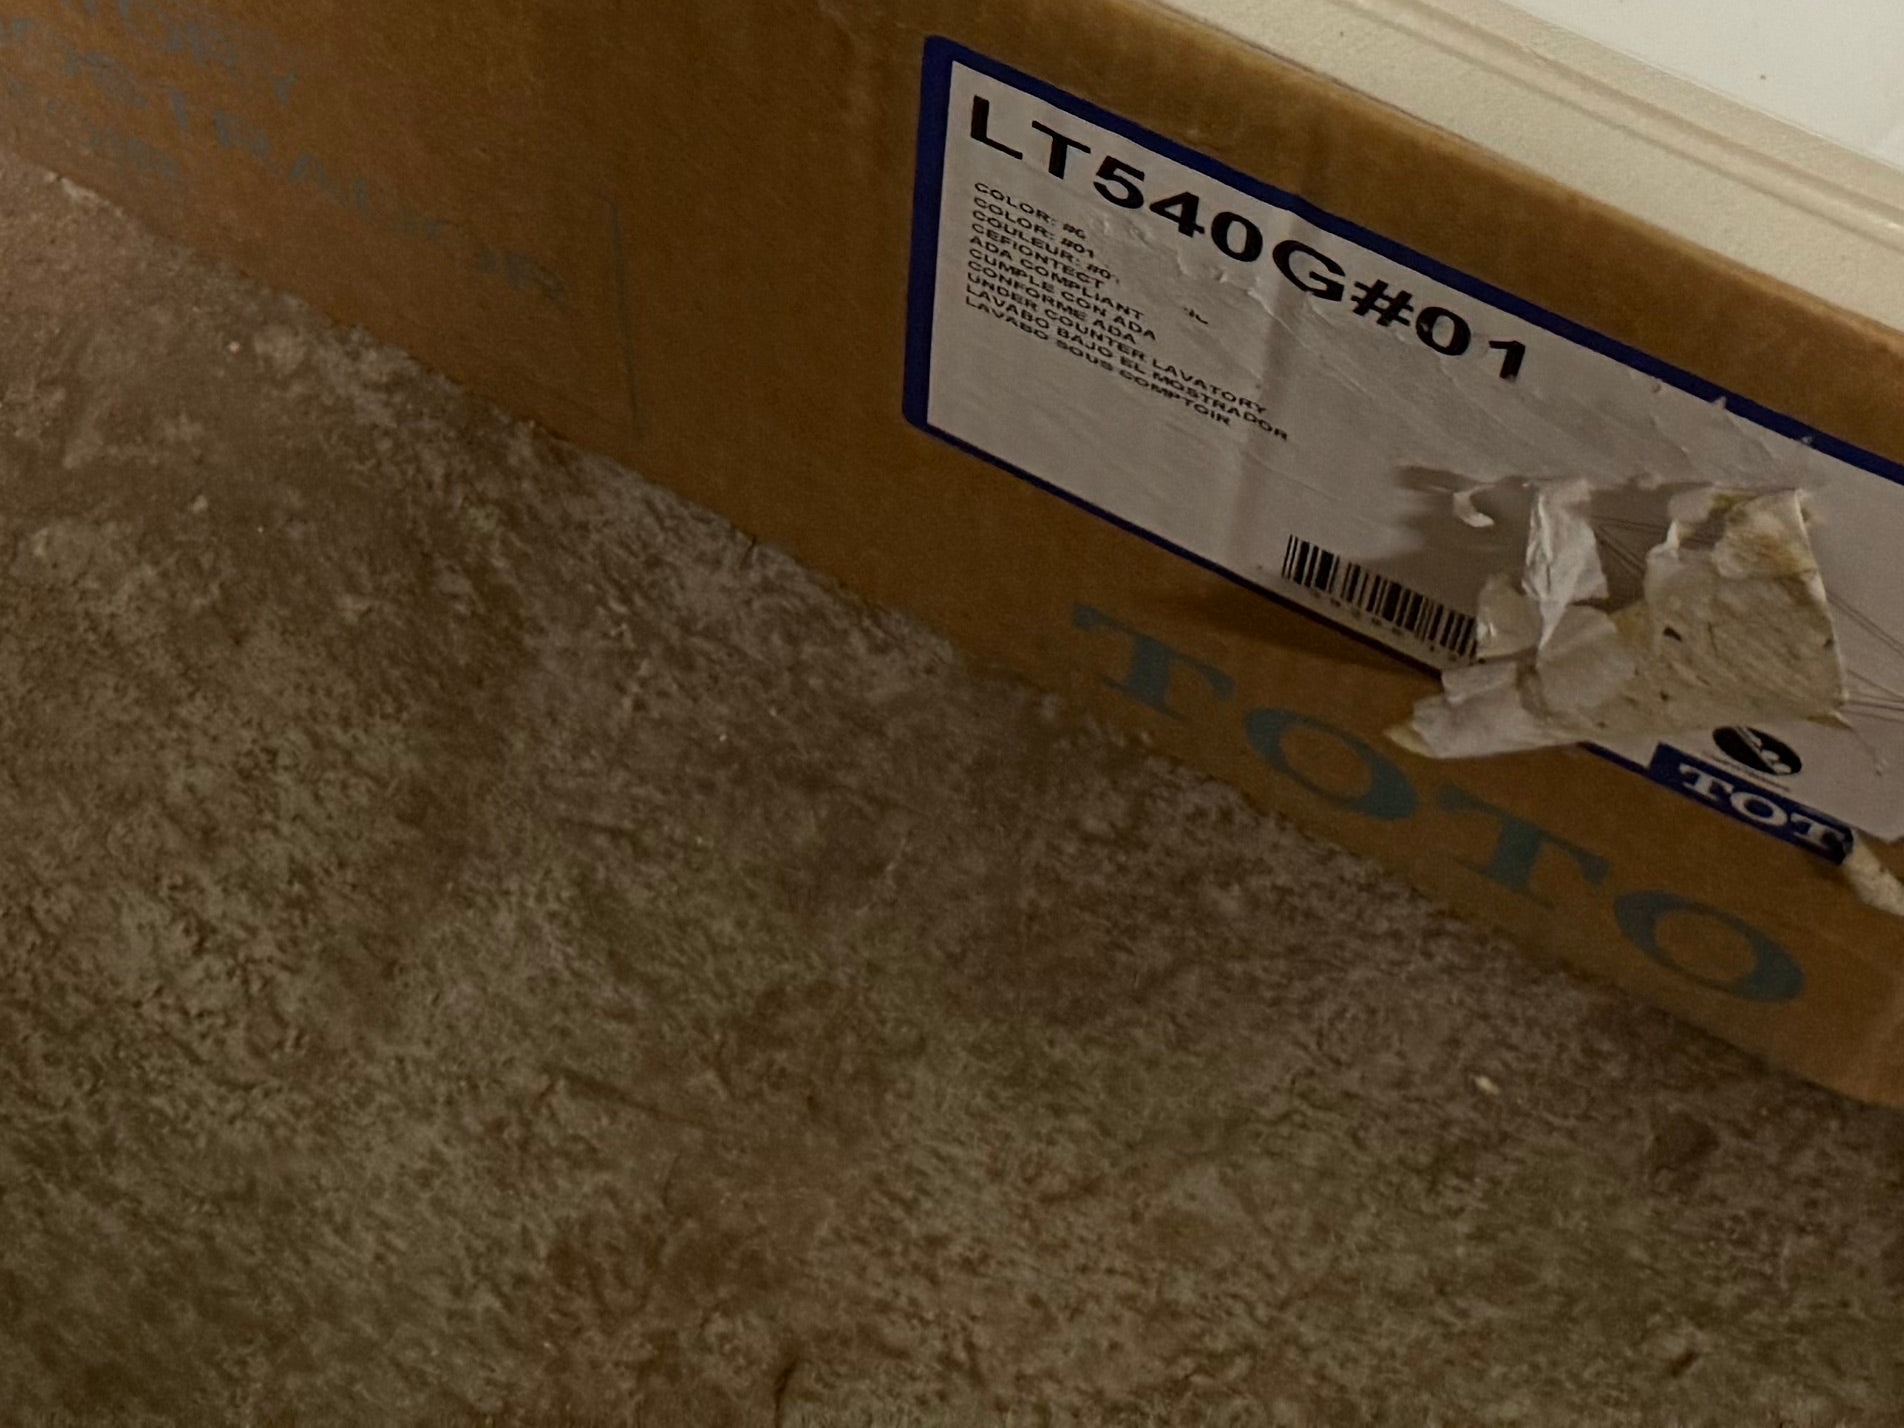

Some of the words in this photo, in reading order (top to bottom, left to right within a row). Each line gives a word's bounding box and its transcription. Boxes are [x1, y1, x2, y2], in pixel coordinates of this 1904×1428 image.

[970, 94, 1527, 383] LT540G#01
[972, 209, 1081, 266] COULEUR:
[973, 196, 1055, 241] COLOR:
[974, 181, 1057, 227] COLOR:
[968, 247, 1056, 294] CUMPLE
[1060, 290, 1107, 319] CON
[1112, 315, 1157, 342] ADA
[969, 234, 1013, 262] ADA
[1019, 257, 1145, 320] COMPLIANT
[971, 222, 1105, 290] CEFIONTECT
[967, 259, 1089, 323] CONFORME
[1092, 318, 1137, 345] ADA
[967, 271, 1039, 313] UNDER
[1044, 308, 1146, 362] COUNTER
[1151, 357, 1268, 415] LAVATORY
[965, 295, 1050, 341] LAVABO
[1055, 339, 1115, 372] SOUS
[1118, 369, 1232, 427] COMPTOIR
[966, 283, 1051, 330] LAVABO
[1056, 326, 1114, 359] BAJO
[1119, 355, 1147, 375] EL
[1152, 371, 1289, 441] MOSTRADOR
[1071, 603, 1808, 1005] TOTO
[1679, 762, 1849, 851] TOT
